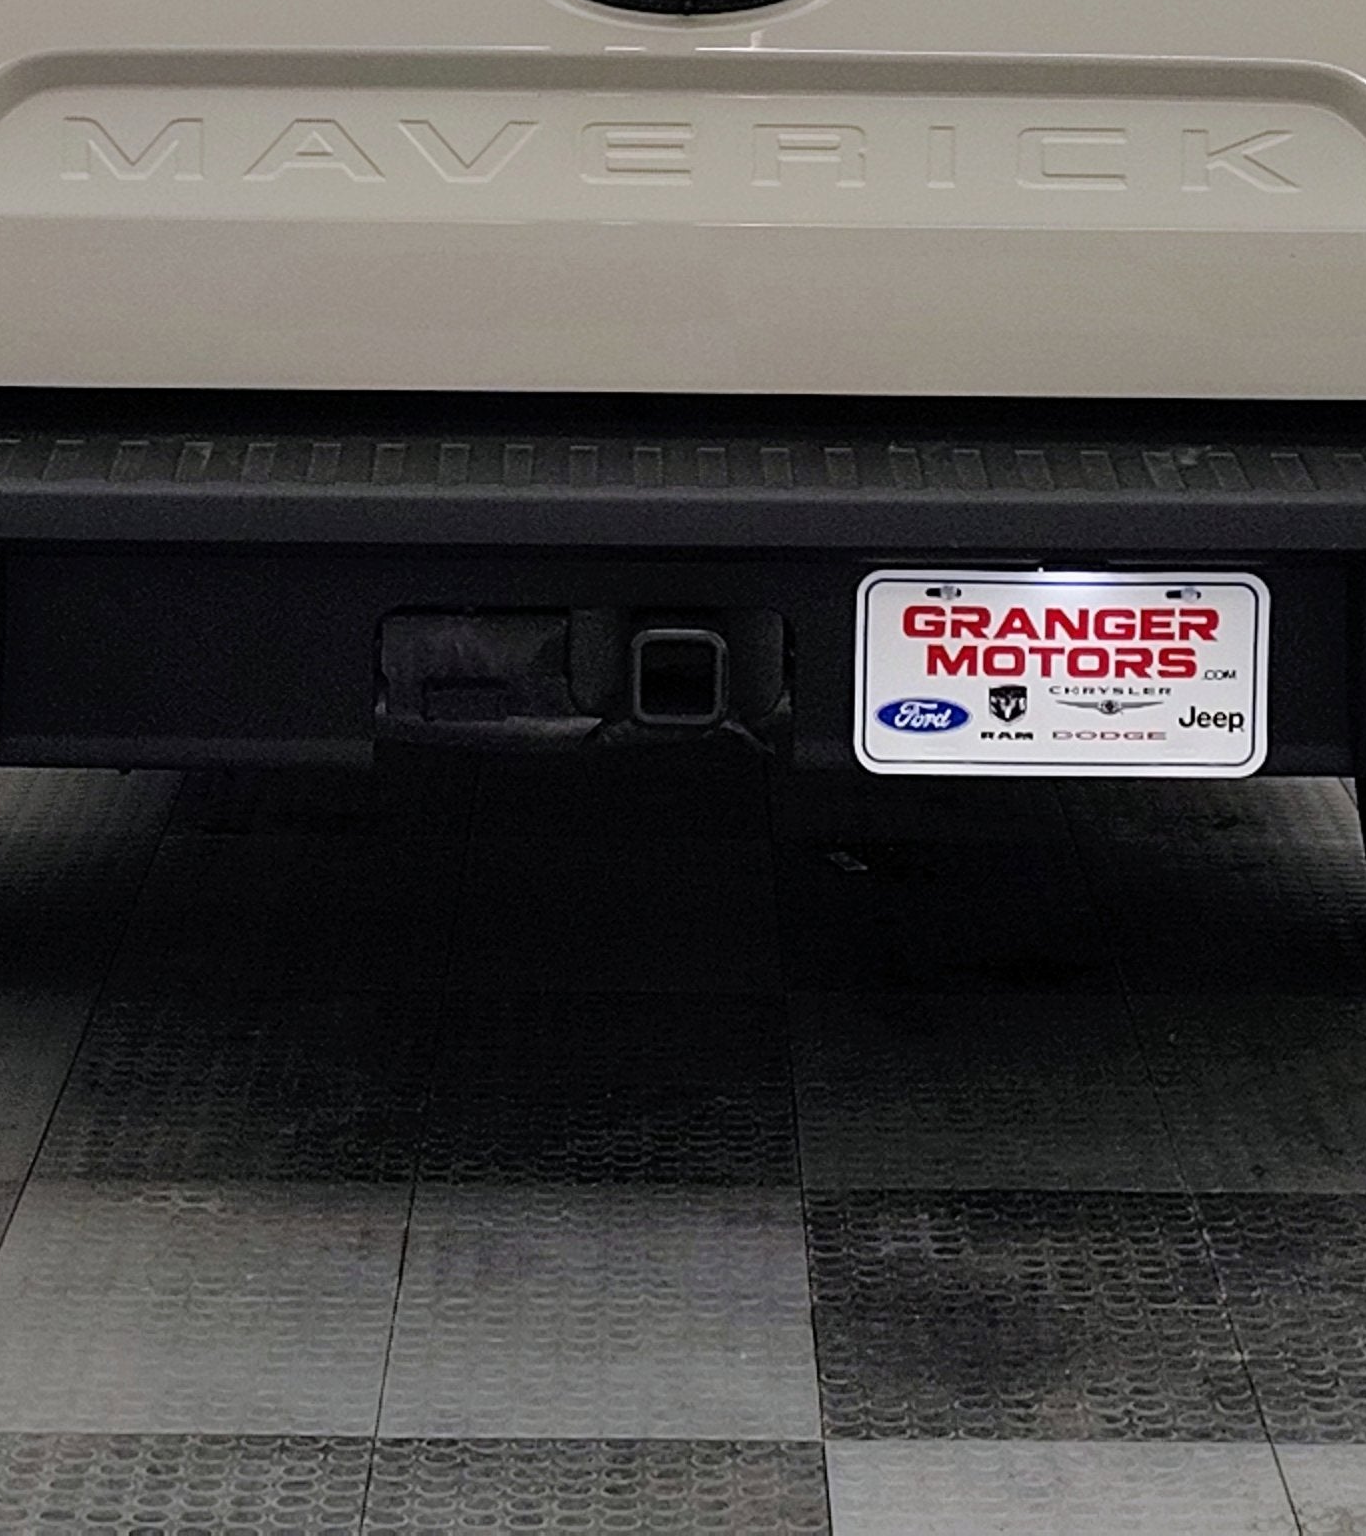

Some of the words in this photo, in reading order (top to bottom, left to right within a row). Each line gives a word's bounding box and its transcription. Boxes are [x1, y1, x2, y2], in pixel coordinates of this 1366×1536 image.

[61, 117, 1302, 193] MAVERICK
[902, 605, 1220, 641] GRANGER
[926, 645, 1197, 679] MOTORS
[1048, 686, 1172, 696] CHRYSLER
[893, 702, 953, 730] Ford
[1178, 706, 1245, 733] Jeep
[980, 731, 1034, 741] RAM
[1052, 731, 1167, 741] DODGE
